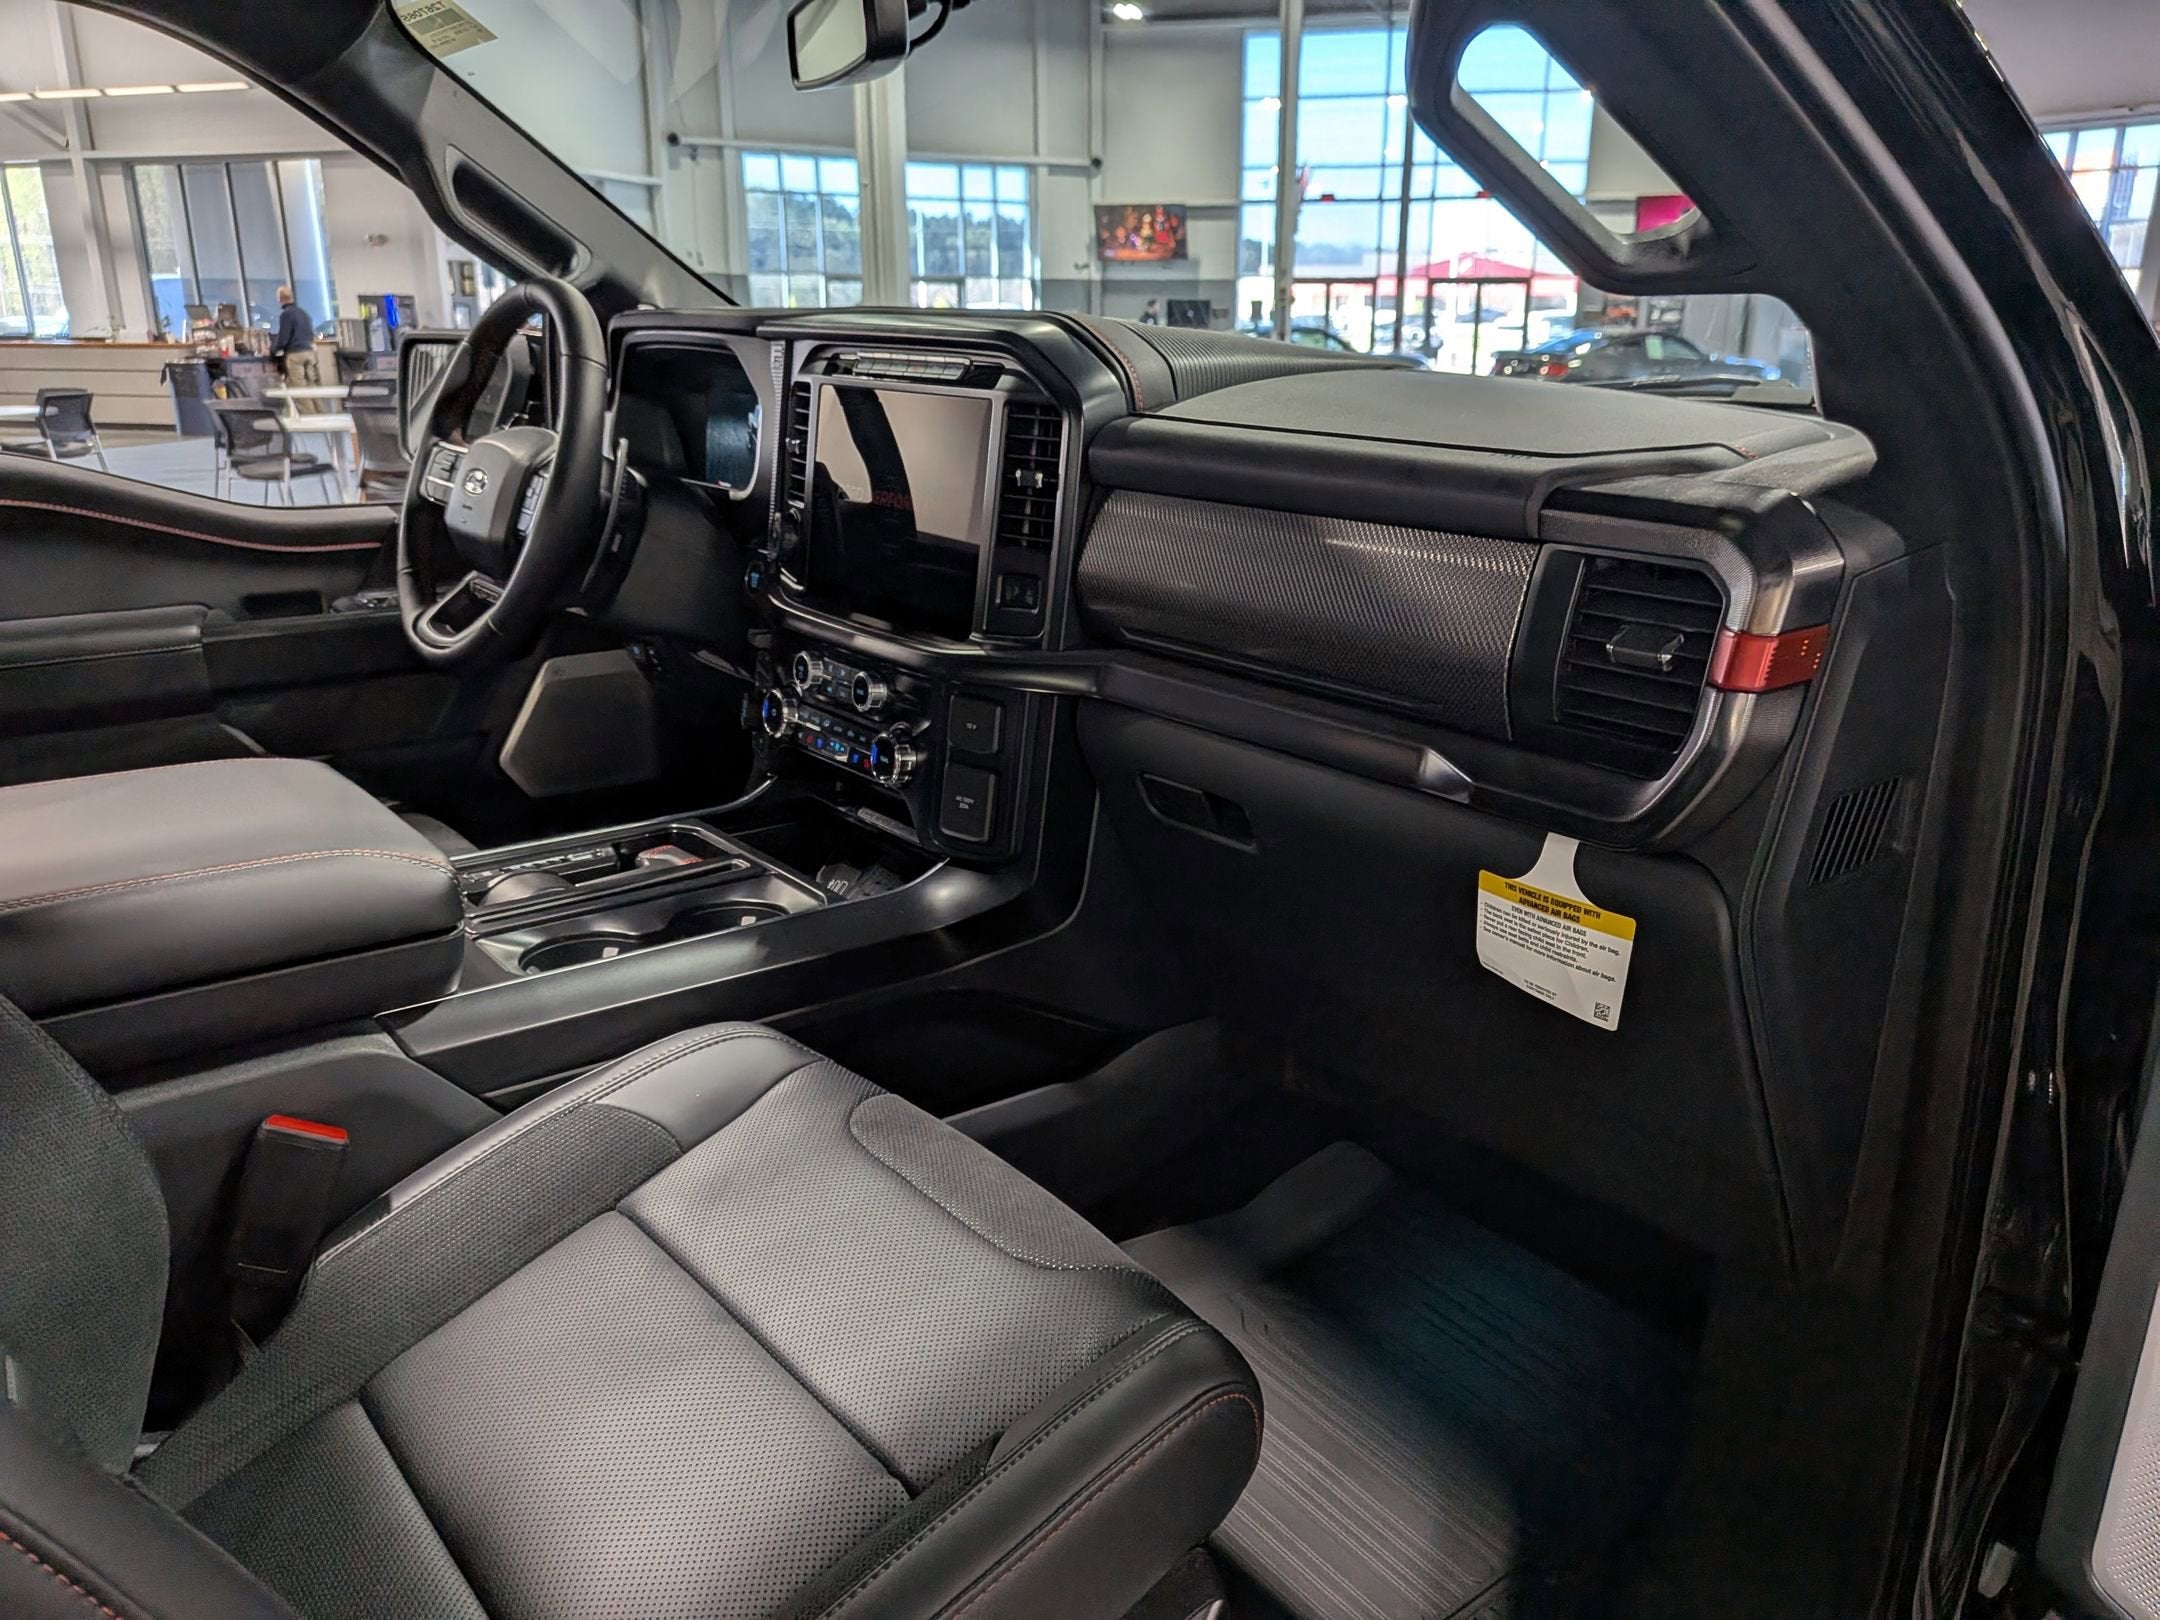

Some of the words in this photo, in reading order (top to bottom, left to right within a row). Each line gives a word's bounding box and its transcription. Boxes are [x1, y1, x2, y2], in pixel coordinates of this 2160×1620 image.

[1504, 882, 1517, 893] THIS
[1518, 887, 1542, 901] VEHICLE
[1551, 898, 1582, 913] EQUIPPED
[1584, 908, 1601, 919] WITH
[1519, 897, 1549, 913] ADVANCED
[1551, 908, 1561, 917] AIR
[1563, 912, 1580, 922] BAGS
[1483, 920, 1498, 930] Always
[1518, 933, 1529, 943] belts
[1530, 939, 1539, 947] and
[1540, 943, 1551, 952] child
[1484, 914, 1495, 922] Never
[1518, 928, 1532, 939] facing
[1533, 935, 1544, 943] child
[1484, 902, 1502, 913] Children
[1519, 916, 1530, 925] killed
[1538, 924, 1560, 936] seriously
[1562, 932, 1580, 943] injured
[1608, 947, 1620, 956] bag.
[1511, 906, 1522, 914] EVEN
[1524, 910, 1535, 919] WITH
[1536, 916, 1561, 928] ADVANCED
[1573, 928, 1586, 936] BAGS
[1527, 925, 1541, 935] safest
[1542, 932, 1555, 941] place
[1565, 940, 1589, 952] Children.
[1510, 938, 1525, 948] manual
[1534, 948, 1545, 957] more
[1546, 954, 1574, 968] information
[1576, 964, 1591, 974] about
[1601, 972, 1616, 982] bags.
